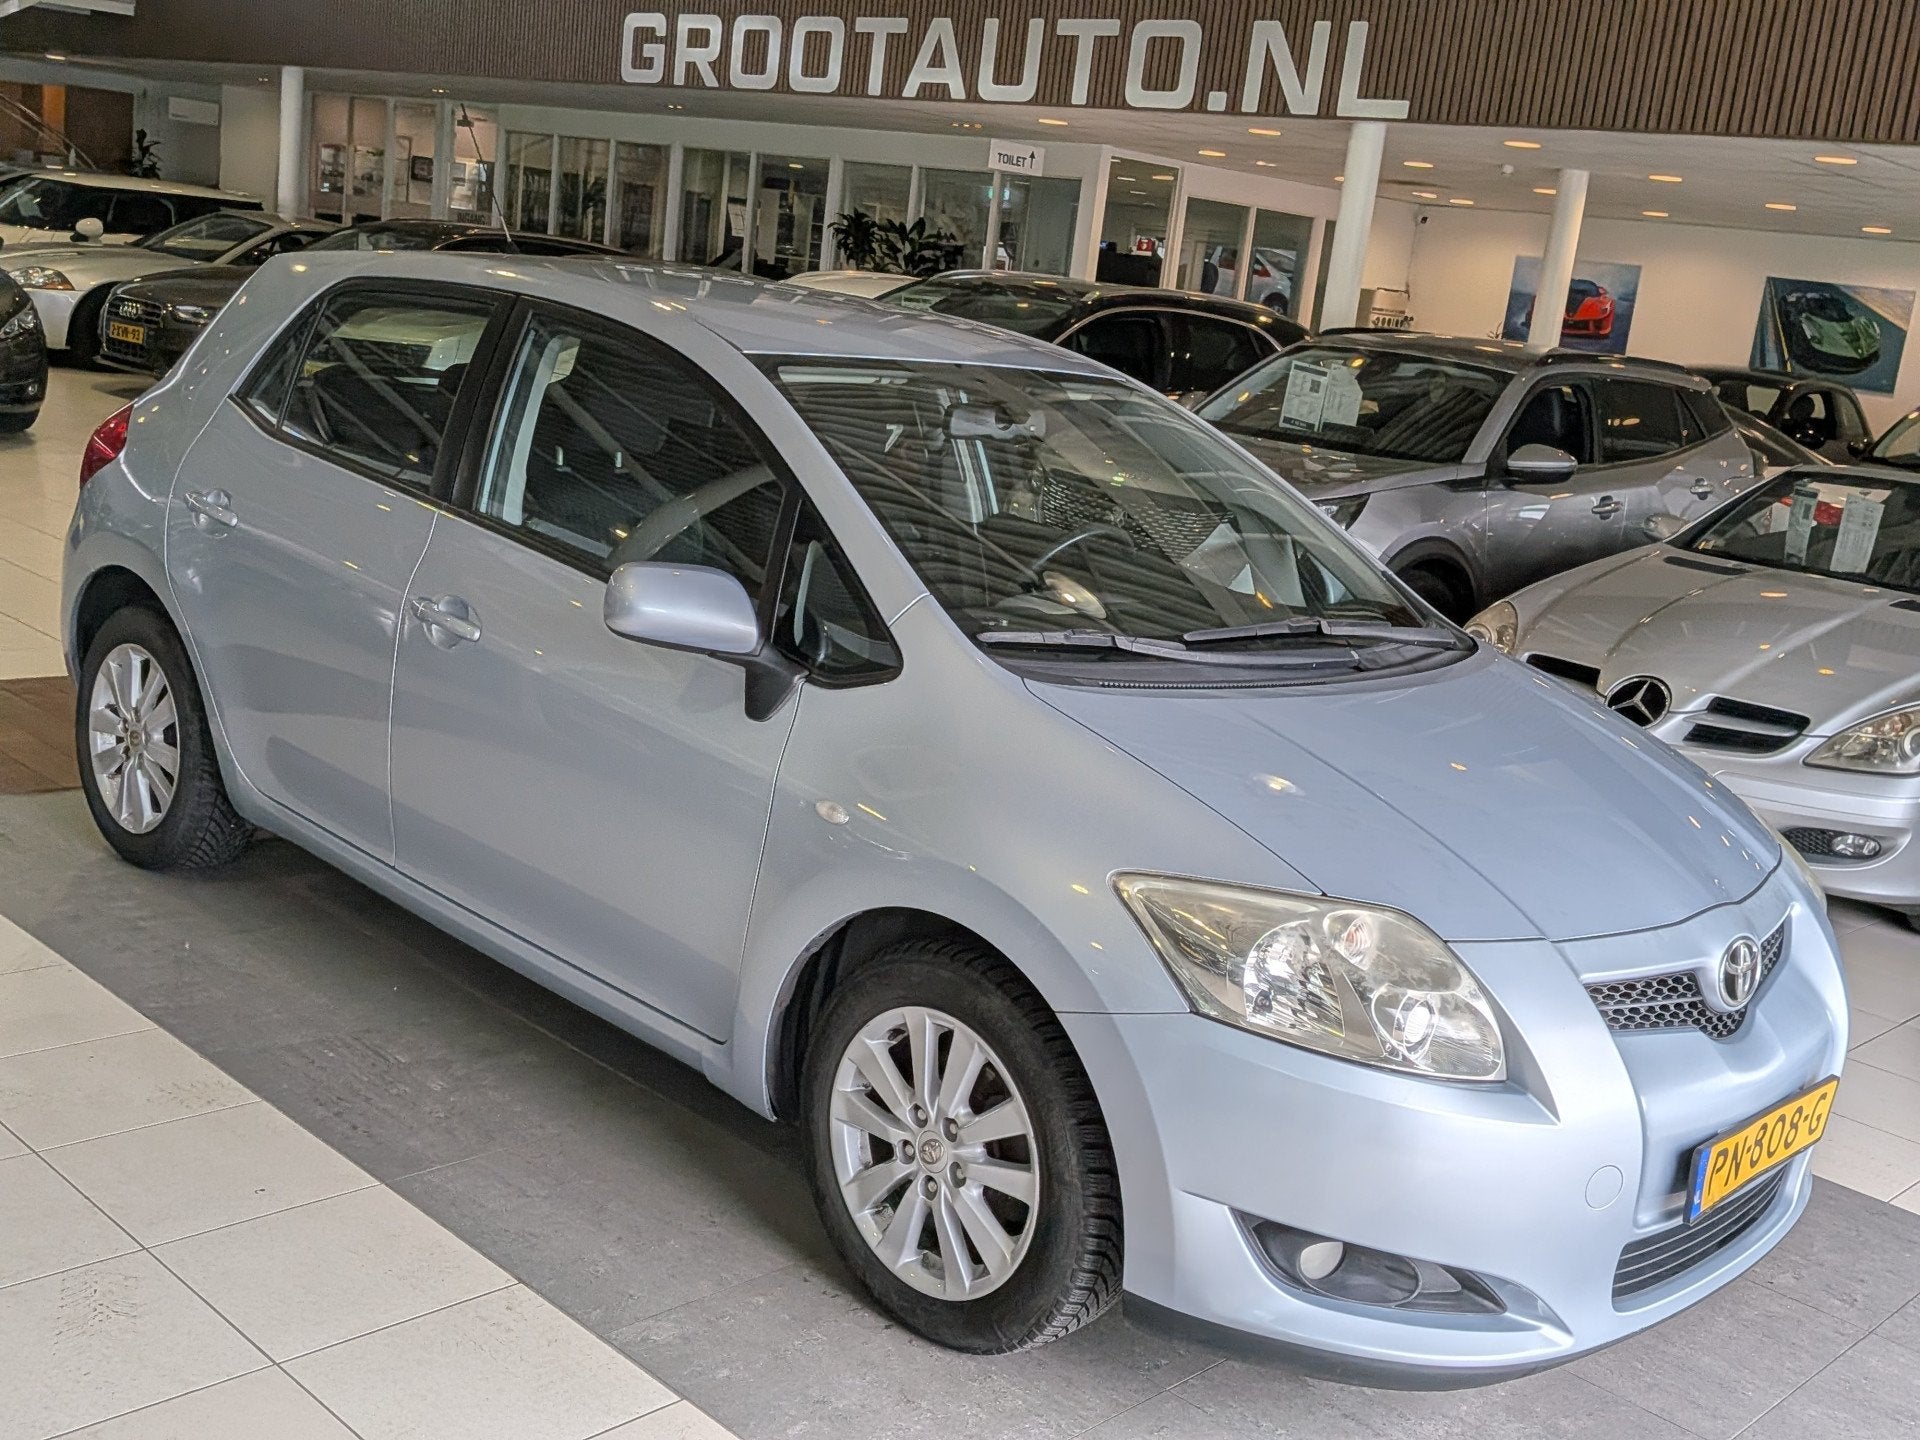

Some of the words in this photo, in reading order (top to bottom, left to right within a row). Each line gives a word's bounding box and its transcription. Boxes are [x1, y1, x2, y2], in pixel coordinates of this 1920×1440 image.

[620, 12, 1410, 120] GROOTAUTO.NL
[997, 152, 1028, 168] TOILET
[1707, 1091, 1828, 1197] PN-808-G
